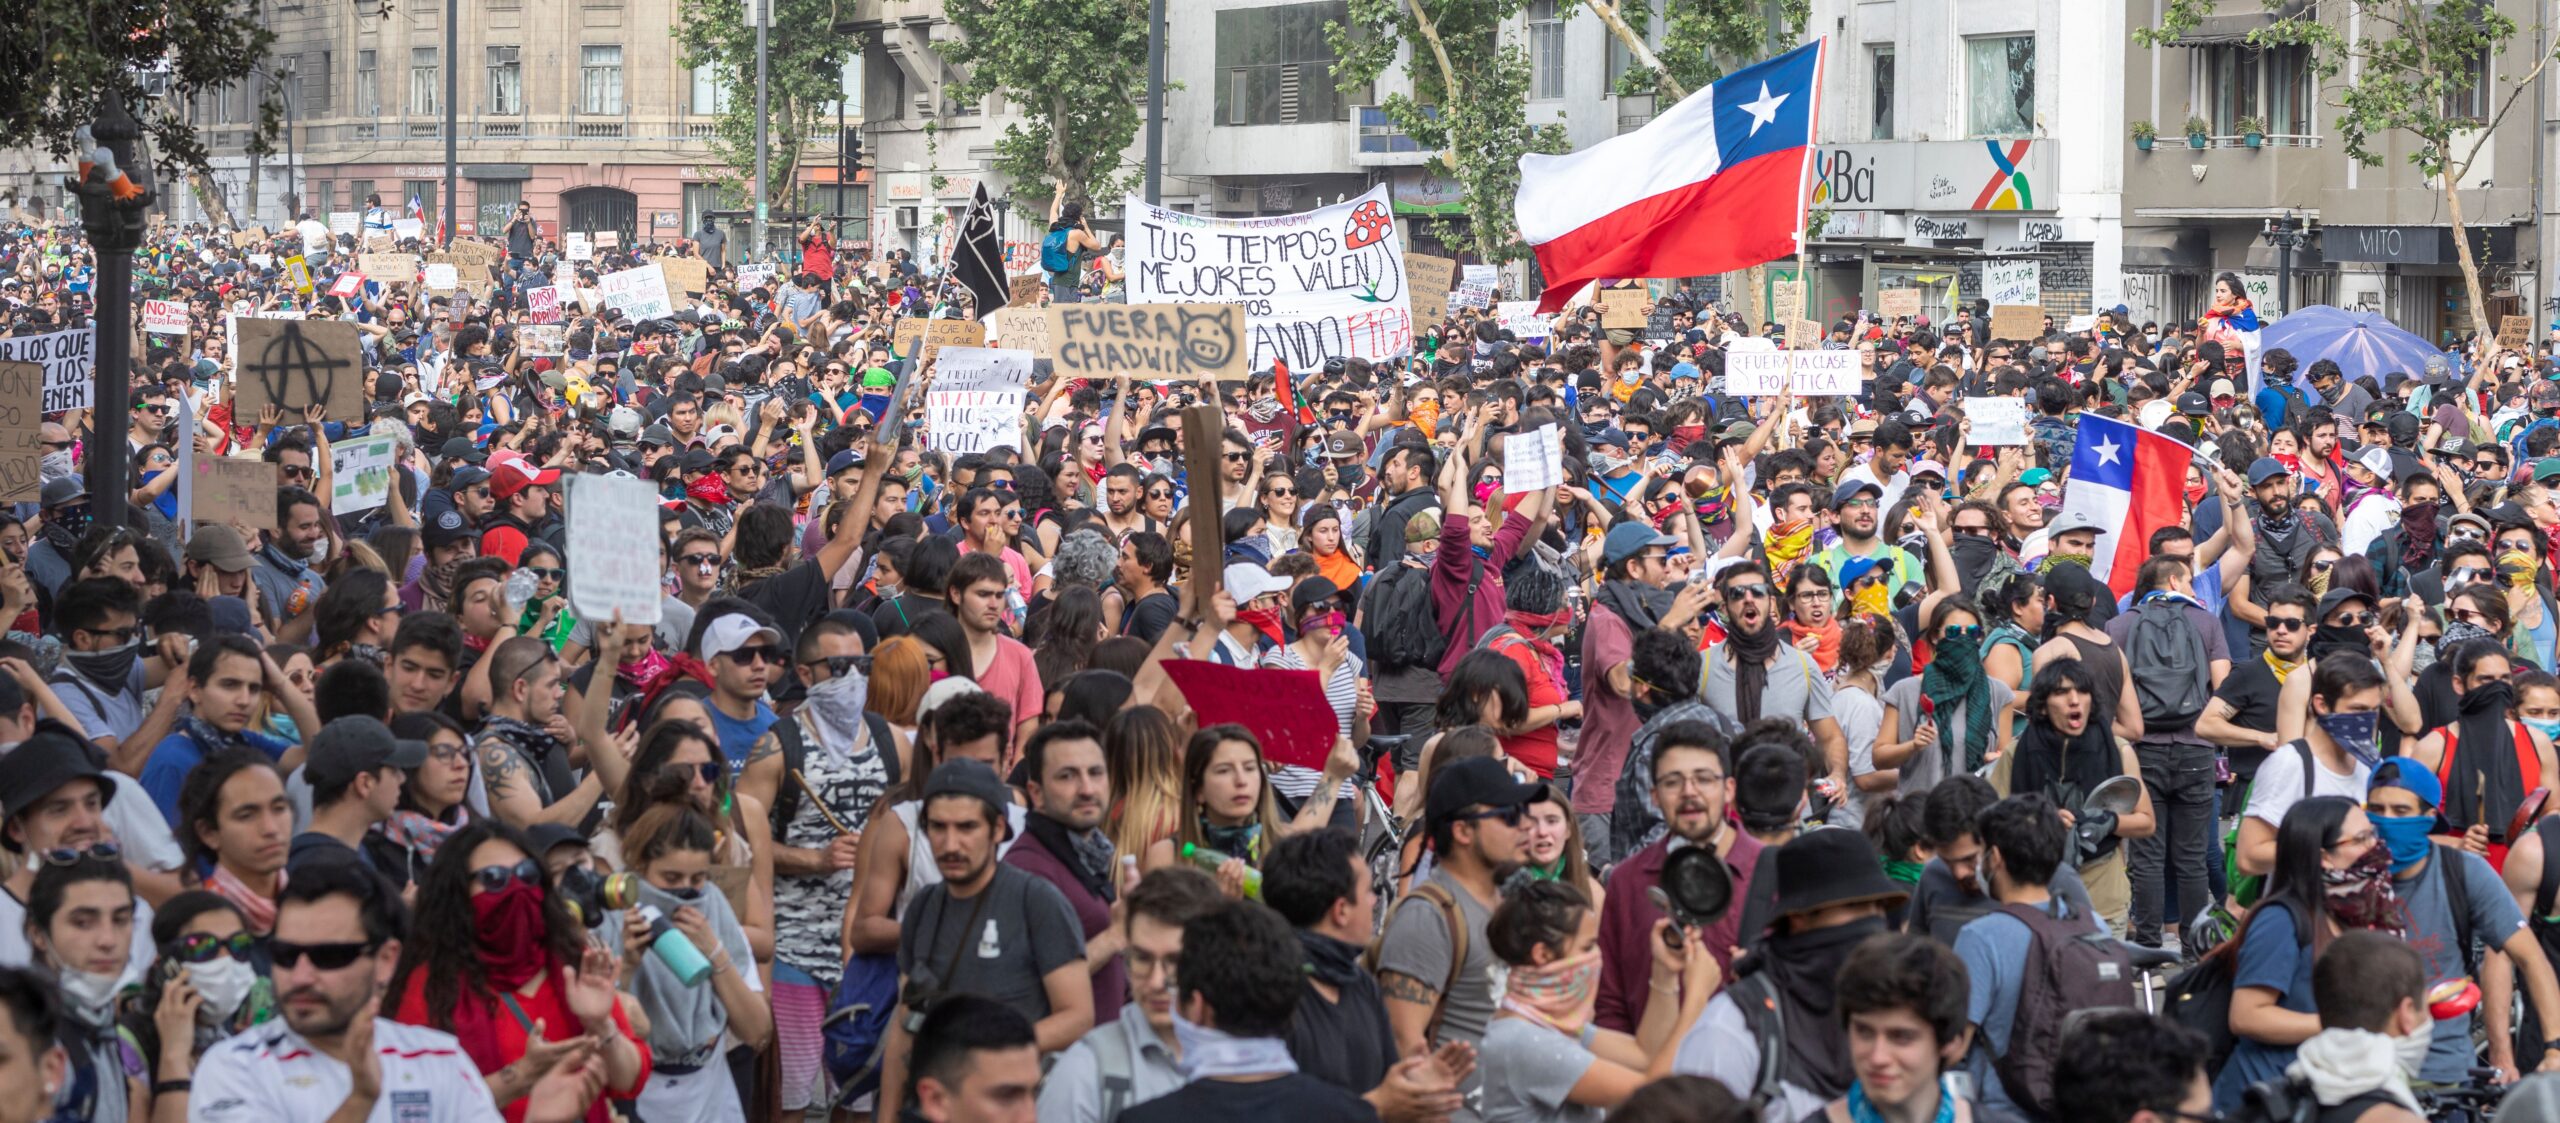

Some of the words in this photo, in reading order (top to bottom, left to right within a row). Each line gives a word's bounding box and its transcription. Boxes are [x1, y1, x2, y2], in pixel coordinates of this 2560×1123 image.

[1833, 149, 1875, 203] Bci
[1141, 222, 1196, 263] TUS
[1217, 227, 1336, 264] TIEMPOS
[2358, 229, 2402, 256] MITO
[1140, 260, 1276, 296] MEJORES
[1293, 251, 1368, 292] VALEN
[145, 316, 166, 325] MIEDO
[146, 301, 166, 316] NO
[1064, 307, 1178, 341] FUERA
[1347, 306, 1412, 359] PEGA
[20, 337, 52, 361] LOS
[55, 332, 91, 359] QUE
[1060, 338, 1194, 374] CHADWIK
[56, 357, 88, 385] LOS
[1744, 356, 1789, 370] FUERA
[1795, 356, 1808, 370] LA
[1812, 354, 1849, 370] CLASE
[1, 363, 32, 398] ÓN
[1759, 371, 1838, 391] POLÍTICA
[42, 384, 85, 412] ENEN
